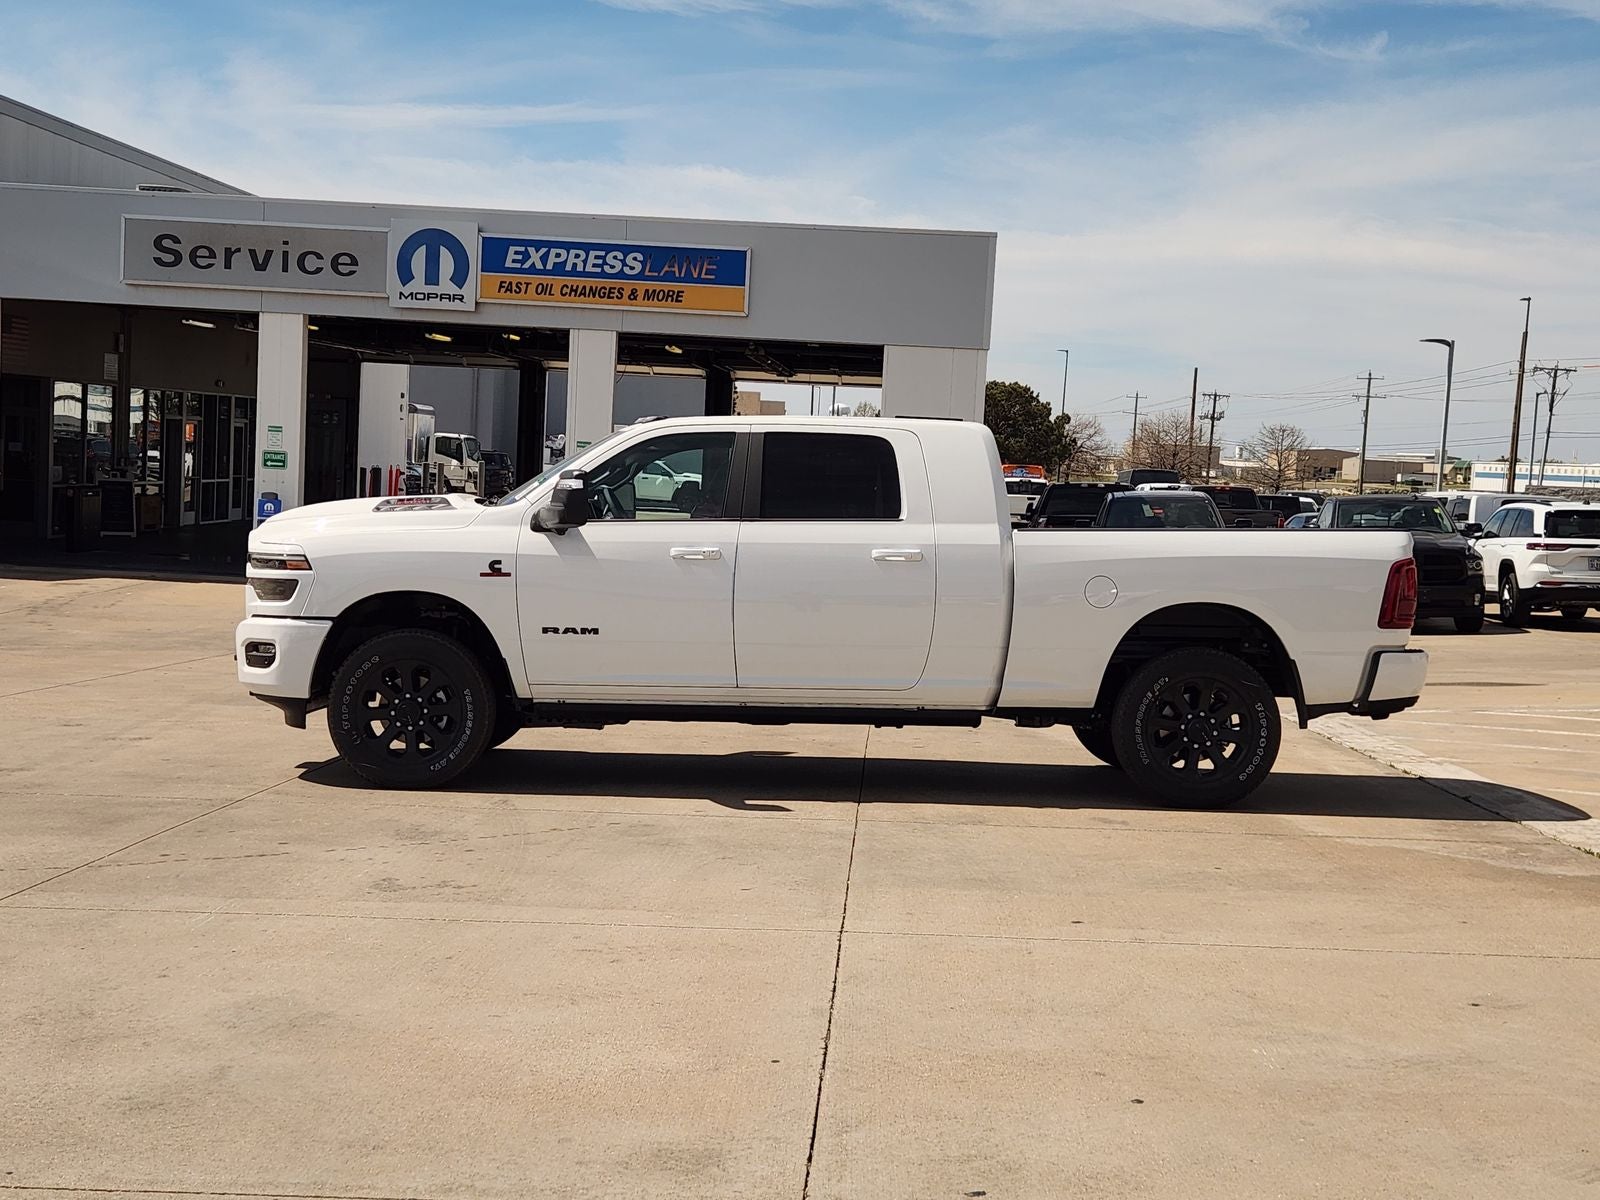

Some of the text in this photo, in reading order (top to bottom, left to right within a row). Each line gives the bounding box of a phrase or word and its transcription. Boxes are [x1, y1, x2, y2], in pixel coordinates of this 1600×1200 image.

[152, 233, 359, 277] Service
[399, 291, 466, 304] MOPAR
[497, 281, 685, 303] FAST OIL CHANGES & MORE
[264, 453, 285, 461] ENTRANCE
[541, 627, 599, 635] RAM
